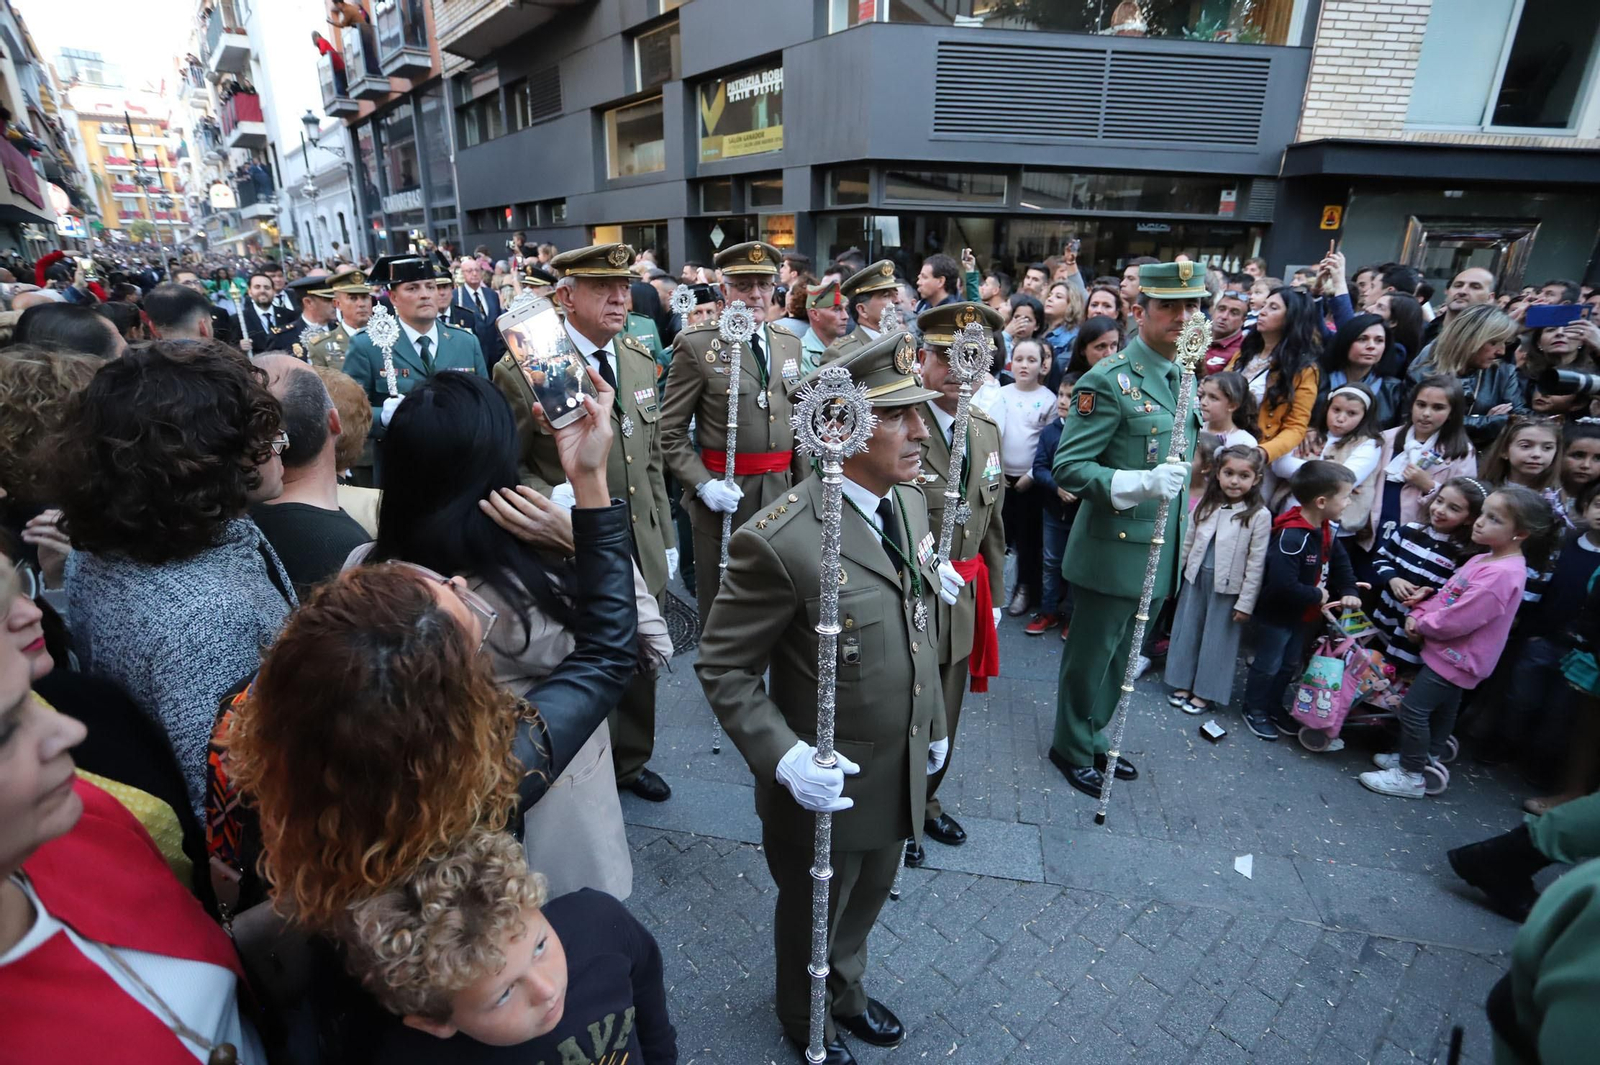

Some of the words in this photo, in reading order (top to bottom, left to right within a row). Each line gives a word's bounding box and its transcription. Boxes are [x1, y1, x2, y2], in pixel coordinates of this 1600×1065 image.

[727, 74, 760, 94] PATRIZIA
[729, 90, 750, 103] HAIR
[743, 131, 765, 141] GANADOR
